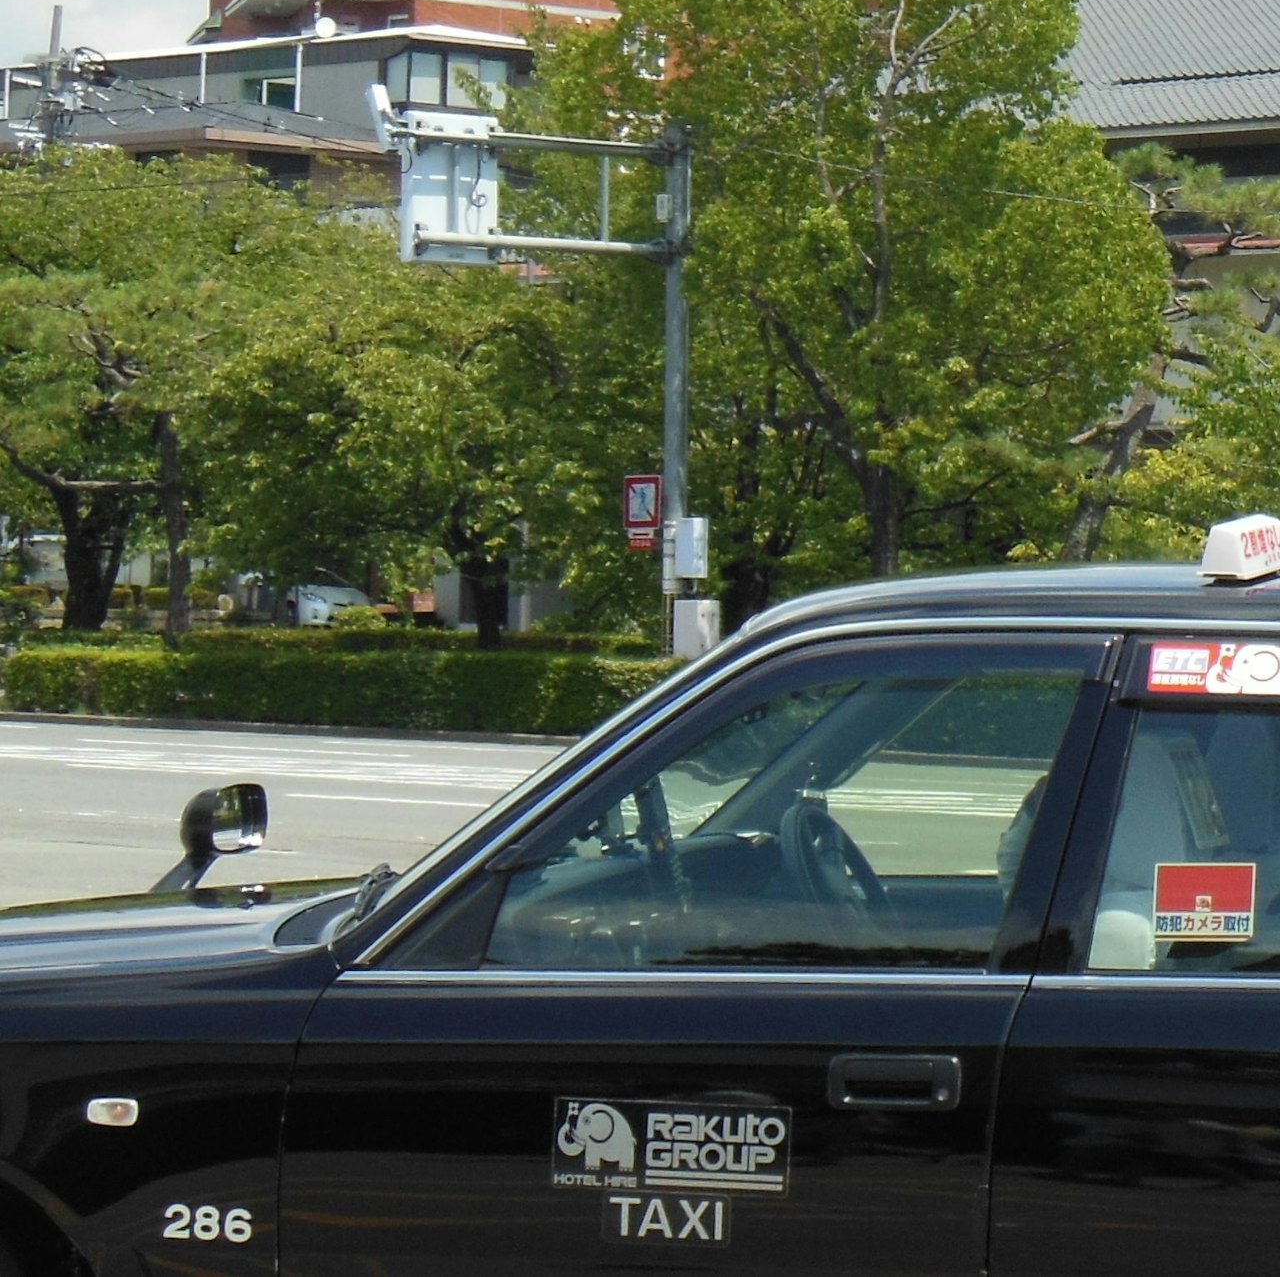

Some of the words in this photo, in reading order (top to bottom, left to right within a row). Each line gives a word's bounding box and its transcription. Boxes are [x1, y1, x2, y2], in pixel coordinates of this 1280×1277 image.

[1156, 650, 1203, 671] ETC
[1156, 915, 1250, 932] 防犯カメラ取付
[645, 1141, 776, 1172] GROUP
[553, 1173, 602, 1187] HOTEL
[604, 1175, 637, 1188] HIRE
[163, 1204, 252, 1243] 286
[609, 1196, 723, 1240] TAXI
